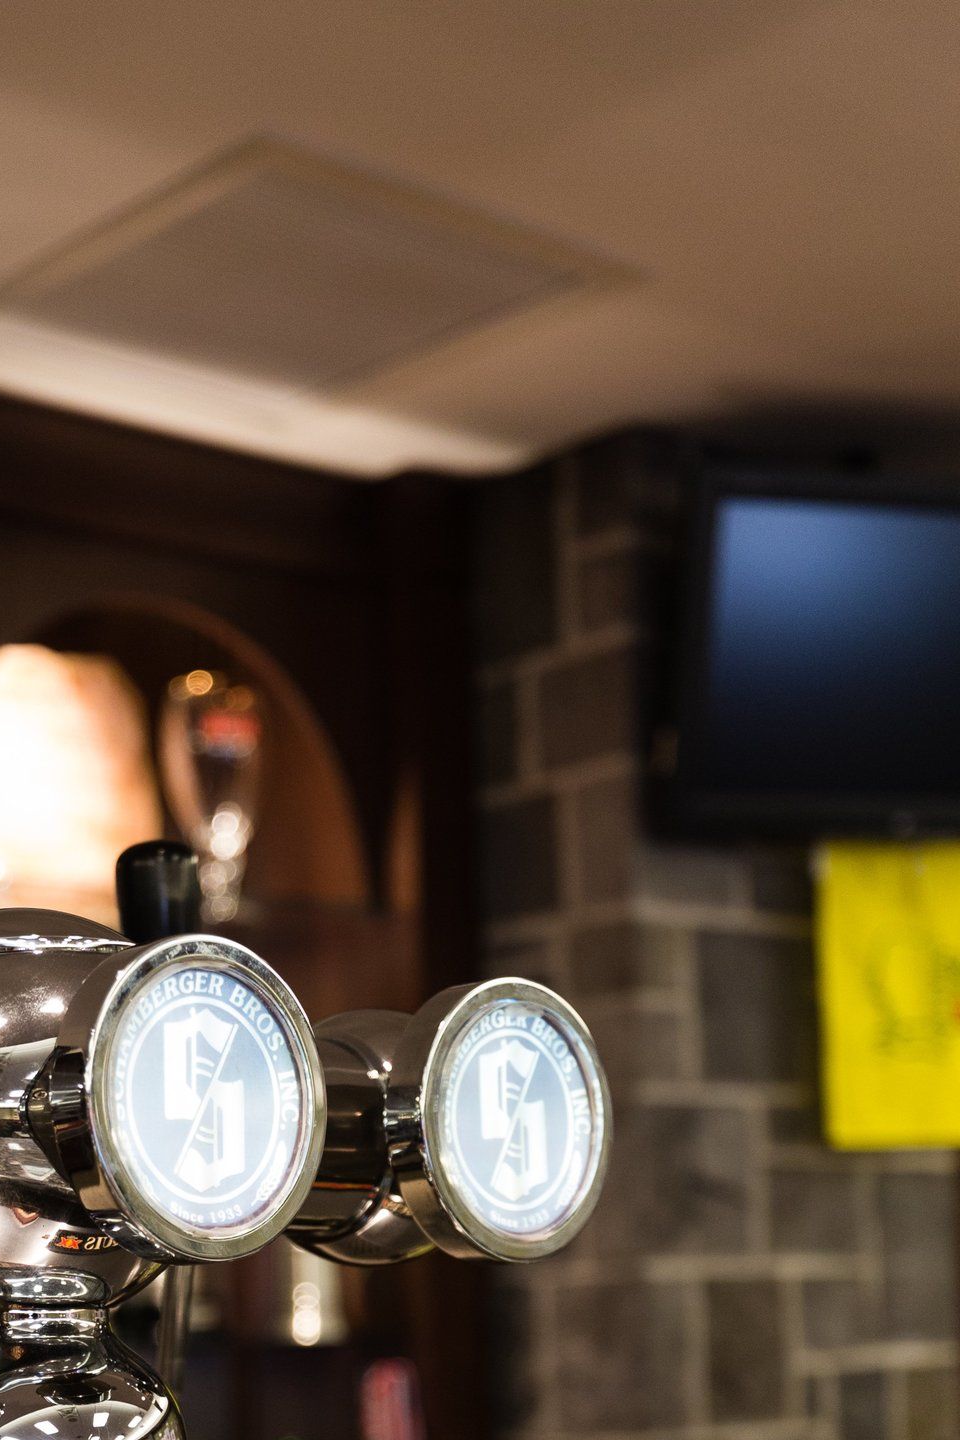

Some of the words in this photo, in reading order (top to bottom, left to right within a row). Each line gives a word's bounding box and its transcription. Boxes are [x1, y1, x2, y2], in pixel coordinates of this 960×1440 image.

[229, 985, 284, 1062] BROS.
[279, 1069, 299, 1130] INC.
[570, 1089, 590, 1142] INC.
[169, 1201, 204, 1224] Since
[209, 1205, 242, 1224] 1933
